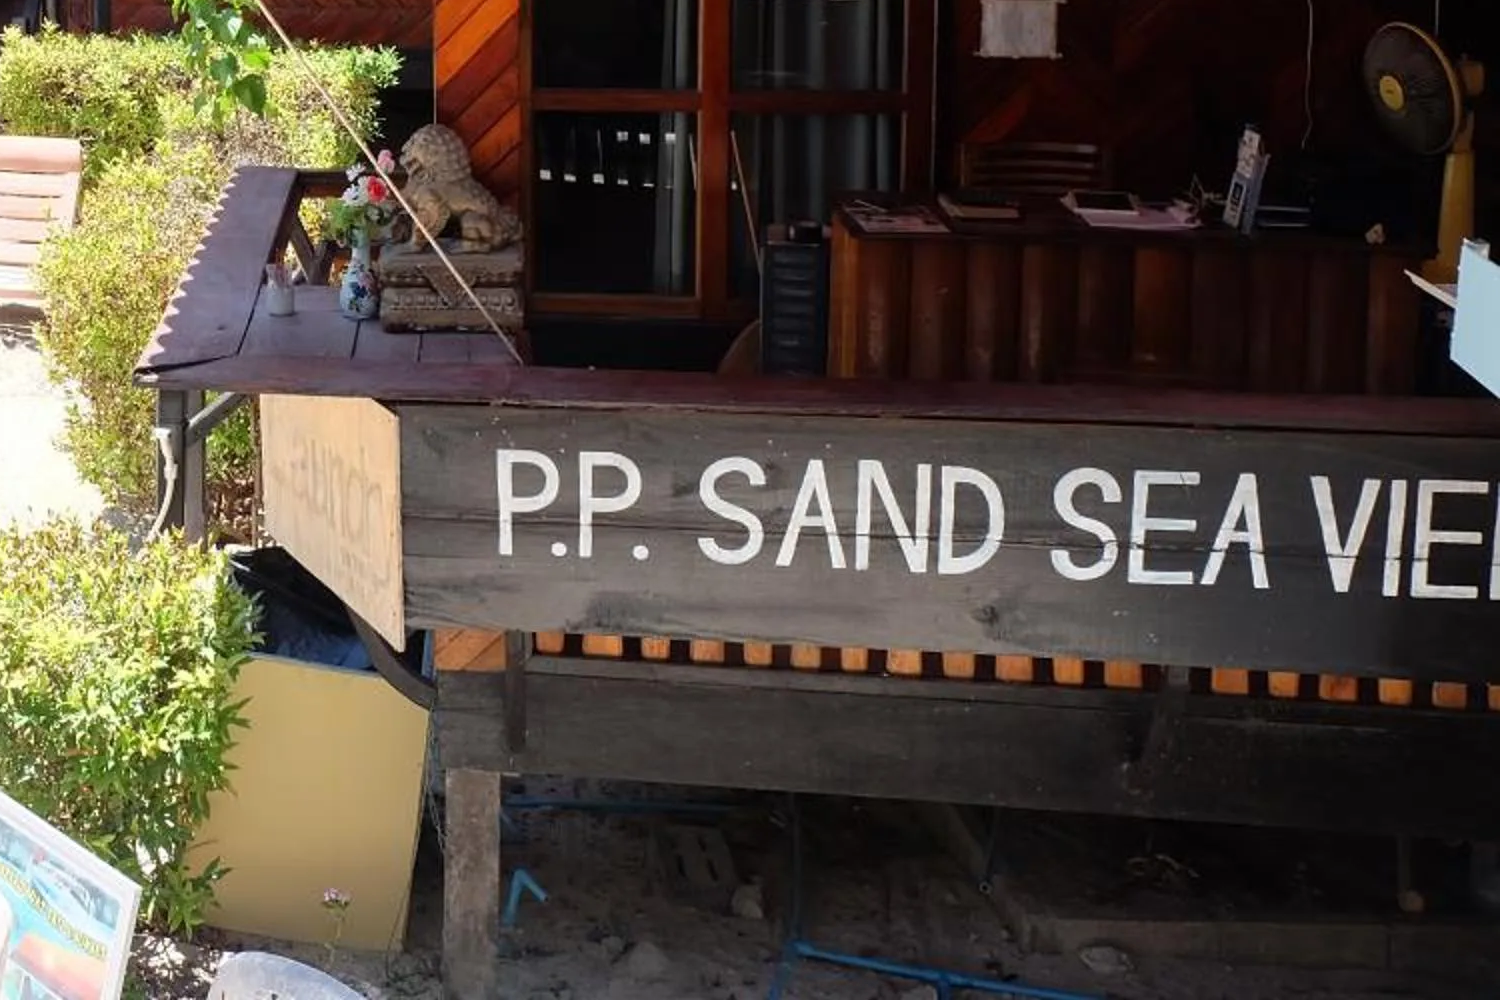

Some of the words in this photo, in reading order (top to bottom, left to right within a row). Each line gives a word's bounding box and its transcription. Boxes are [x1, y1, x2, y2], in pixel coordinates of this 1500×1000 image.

[495, 448, 650, 561] P.P.
[697, 456, 1005, 576] SAND
[1051, 467, 1270, 589] SEA
[1310, 475, 1500, 600] VIE
